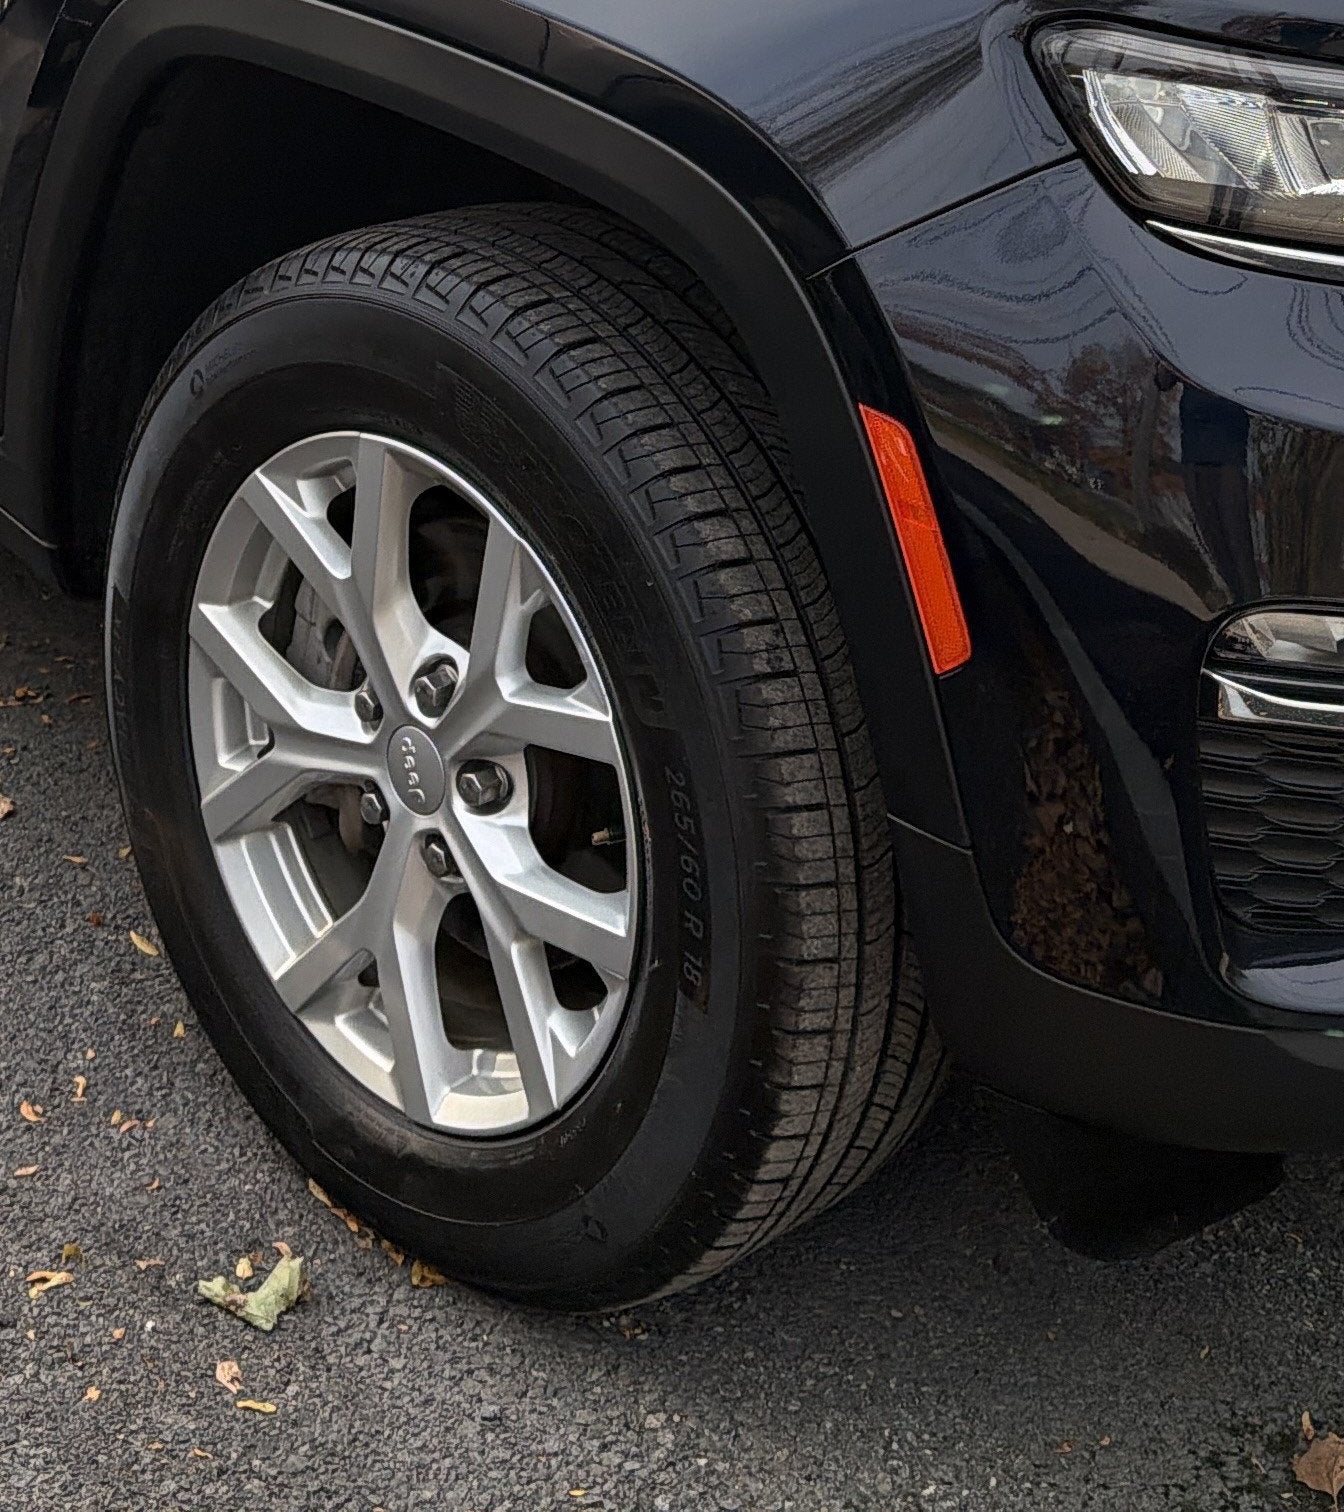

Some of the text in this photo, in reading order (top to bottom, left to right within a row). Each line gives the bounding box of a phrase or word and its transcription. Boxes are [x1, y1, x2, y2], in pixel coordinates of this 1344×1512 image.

[664, 764, 704, 988] 265/60 R 18
